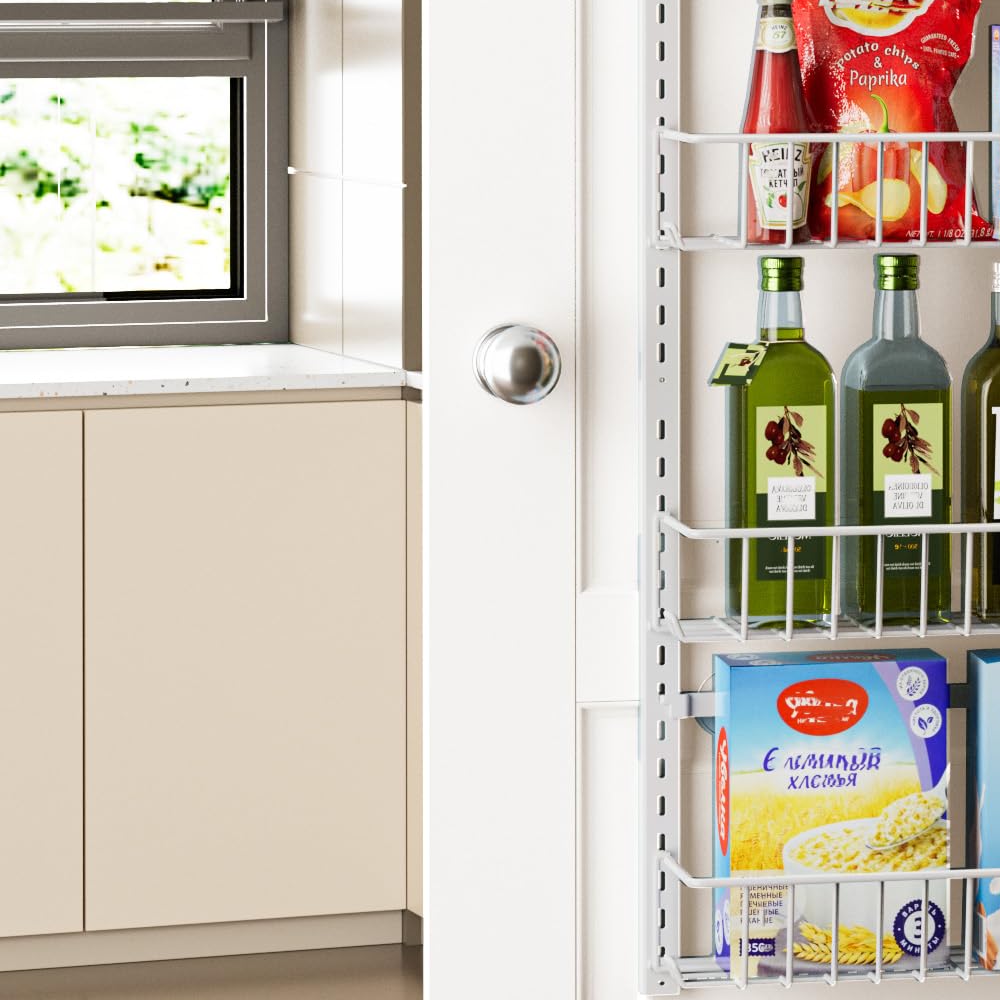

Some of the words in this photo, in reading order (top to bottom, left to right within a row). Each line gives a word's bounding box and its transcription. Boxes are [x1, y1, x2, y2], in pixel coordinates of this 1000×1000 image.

[836, 42, 879, 70] potato
[884, 45, 920, 70] chips
[873, 56, 882, 69] &
[850, 68, 907, 91] Paprika
[769, 179, 798, 188] КЕТЧП
[901, 903, 937, 918] ВАРТЬ
[900, 936, 940, 953] МИНТЫ
